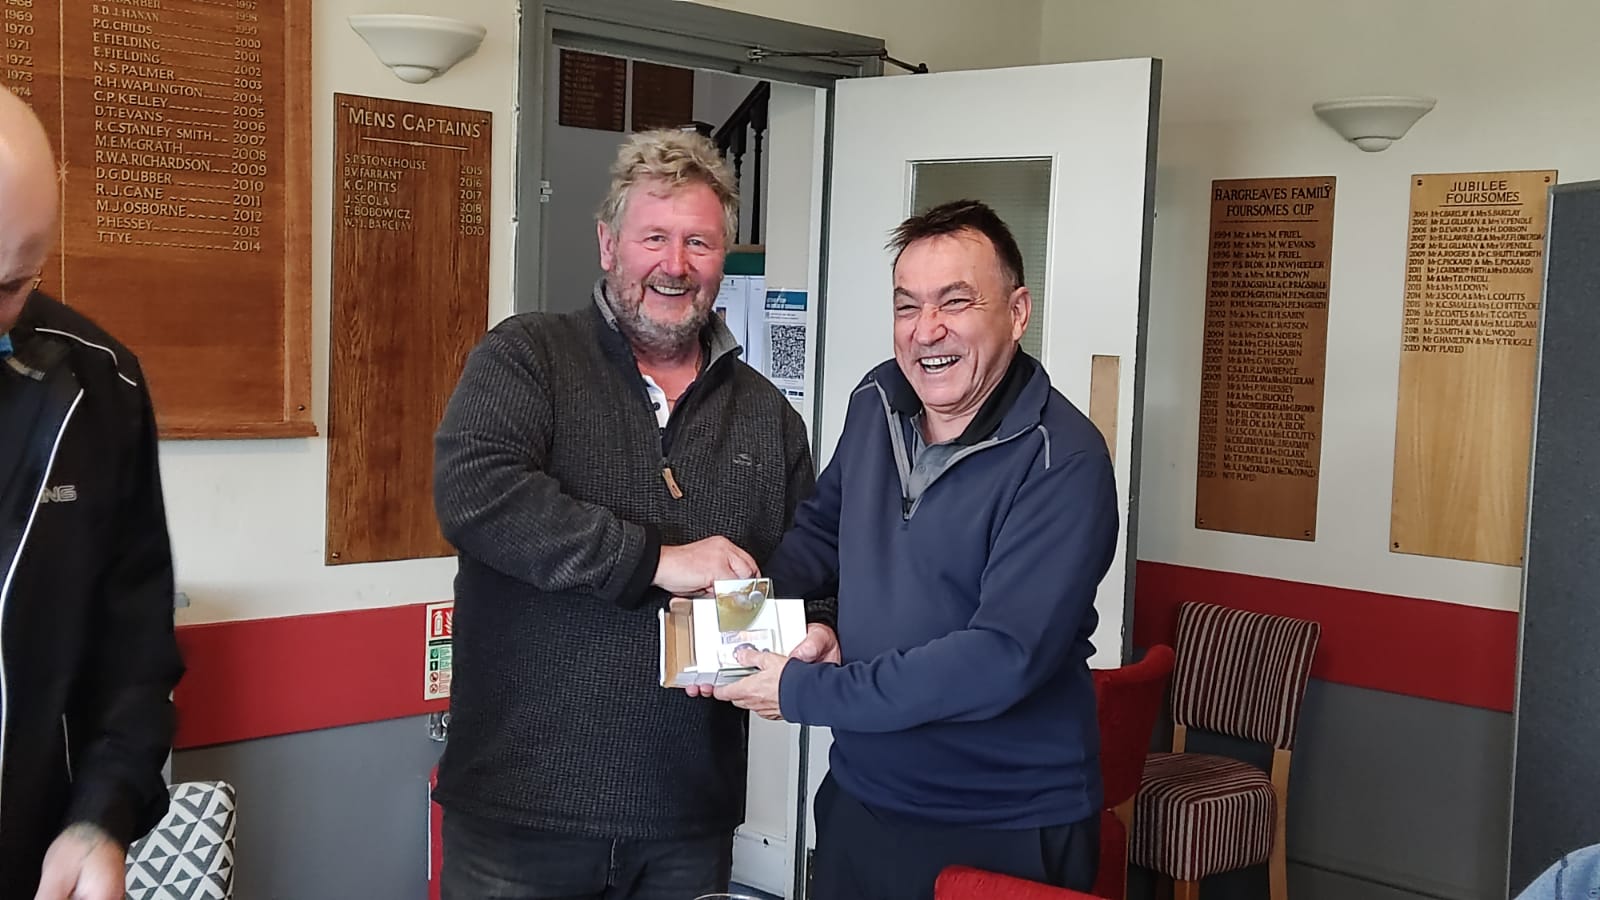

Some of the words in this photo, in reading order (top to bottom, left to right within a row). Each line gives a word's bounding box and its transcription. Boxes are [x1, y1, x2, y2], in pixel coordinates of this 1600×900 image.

[5, 9, 33, 21] 1969
[5, 22, 34, 35] 1970
[6, 38, 30, 50] 1971
[235, 38, 261, 49] 2000
[7, 53, 33, 66] 1972
[234, 51, 261, 62] 2001
[234, 65, 262, 76] 2002
[234, 78, 263, 90] 2003
[233, 92, 264, 104] 2004
[233, 106, 265, 118] 2005
[233, 120, 266, 132] 2006
[349, 107, 396, 129] MENS
[402, 114, 481, 138] CAPTAINS
[176, 128, 212, 142] SMITH
[233, 133, 266, 146] 2007
[232, 148, 267, 161] 2008
[231, 163, 267, 176] 2009
[232, 179, 265, 192] 2010
[1450, 180, 1508, 192] JUBILEE
[460, 190, 482, 200] 2017
[1215, 188, 1287, 200] HARGREAVES
[1292, 186, 1332, 199] FAMILY
[1446, 191, 1520, 204] FOURSOMES
[233, 194, 262, 207] 2011
[460, 203, 482, 214] 2018
[1226, 204, 1289, 217] FOURSOMES
[1293, 203, 1315, 216] CUP
[233, 210, 263, 222] 2012
[460, 214, 482, 224] 2019
[232, 224, 260, 237] 2013
[232, 240, 261, 251] 2014
[1439, 345, 1464, 353] PLAYED
